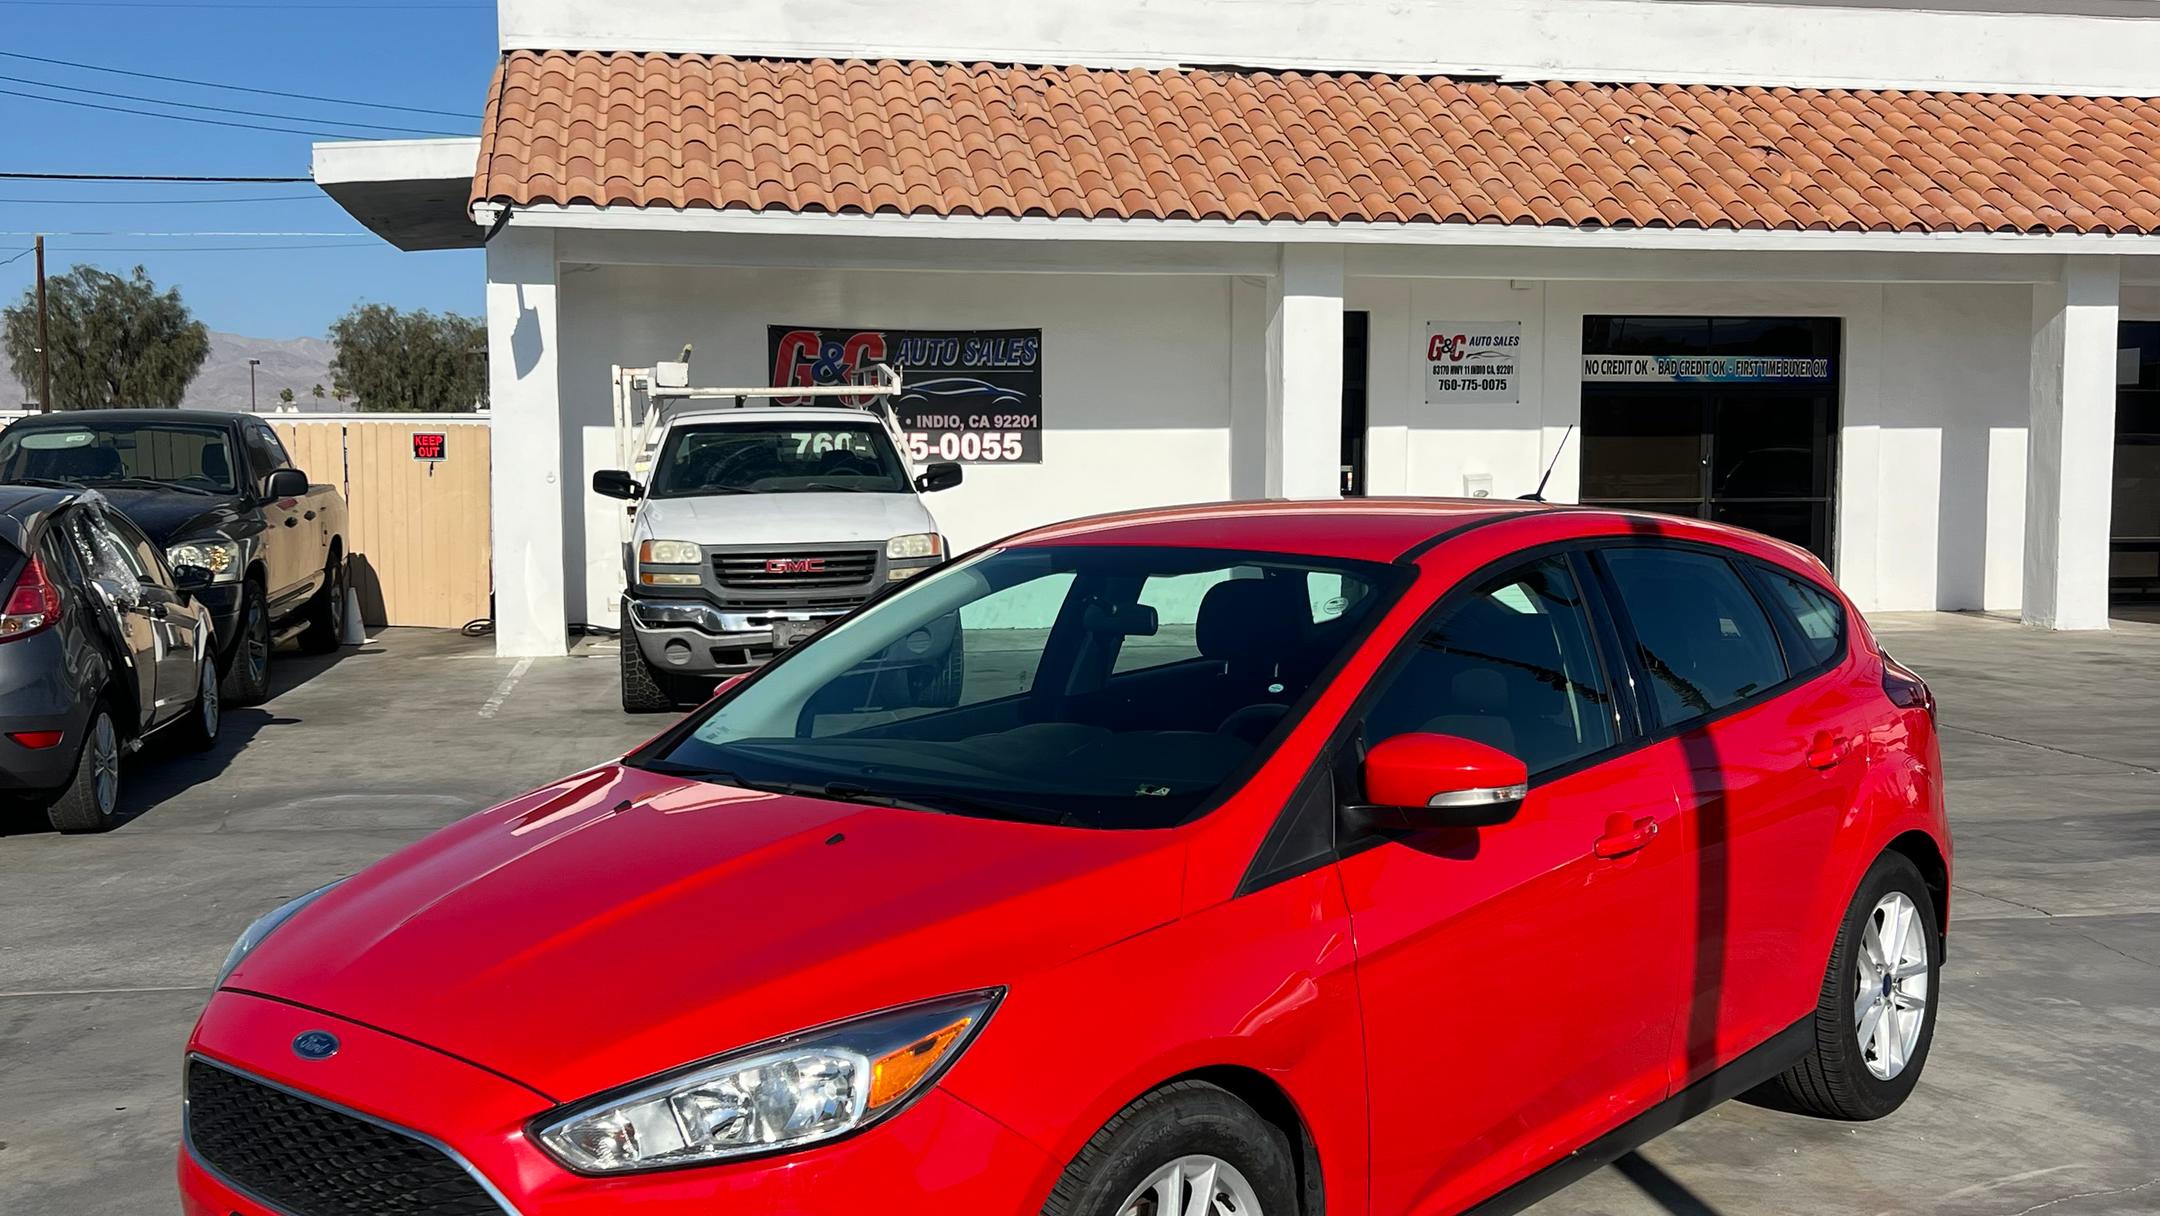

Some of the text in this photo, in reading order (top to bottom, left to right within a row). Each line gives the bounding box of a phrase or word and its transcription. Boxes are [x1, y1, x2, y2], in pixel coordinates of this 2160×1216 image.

[1427, 334, 1520, 362] G&C AUTO SALES
[773, 331, 1038, 409] G&C AUTO SALES
[1432, 365, 1450, 375] 83170
[1450, 365, 1463, 375] HWY
[1496, 365, 1514, 375] 92201
[1584, 359, 1827, 377] NO CREDIT OK BAD CREDIT OK FIRST TIME BUYER OK
[1438, 379, 1507, 391] 760-775-0075
[916, 414, 1038, 431] INDIO, CA 92201
[415, 436, 443, 446] KEEP
[418, 447, 440, 457] OUT
[766, 558, 826, 573] GMC
